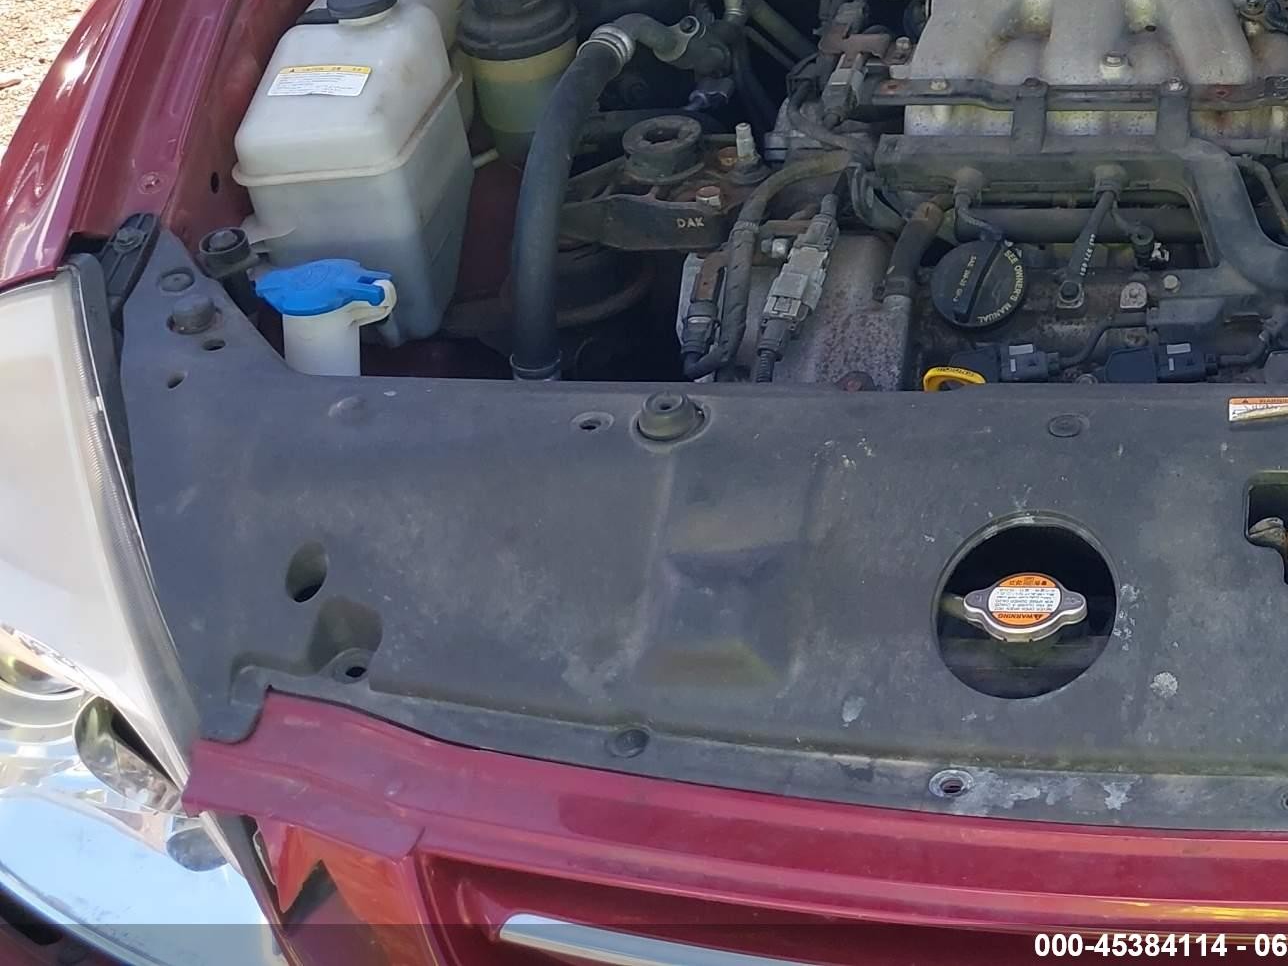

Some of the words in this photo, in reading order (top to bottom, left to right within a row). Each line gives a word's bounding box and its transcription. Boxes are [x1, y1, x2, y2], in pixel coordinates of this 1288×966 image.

[677, 217, 705, 228] DAK
[1004, 249, 1019, 264] SEE
[1010, 265, 1024, 302] OWNER'S
[978, 303, 1012, 323] MANUAL
